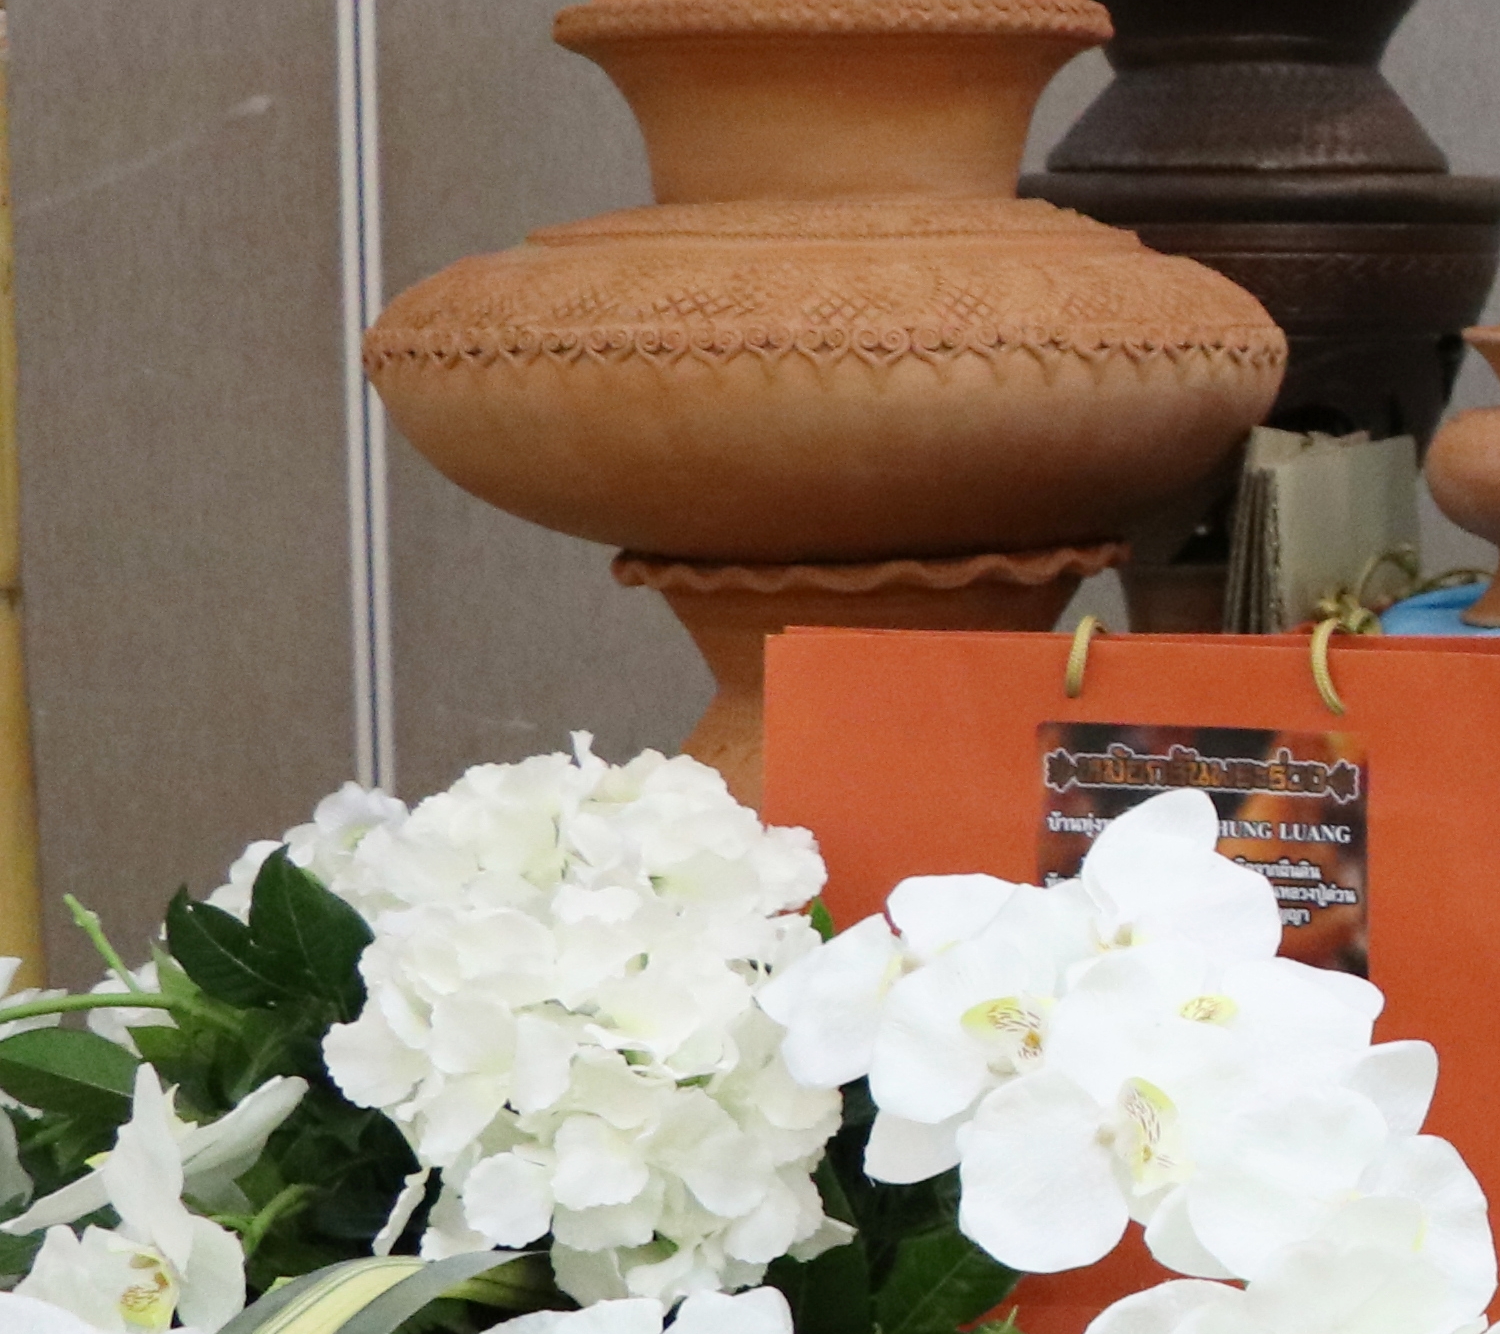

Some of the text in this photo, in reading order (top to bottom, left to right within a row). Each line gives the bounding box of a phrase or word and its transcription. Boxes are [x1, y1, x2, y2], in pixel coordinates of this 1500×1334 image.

[1047, 811, 1108, 838] บ้านทุ่ง
[1217, 819, 1351, 844] HUNG LUANG
